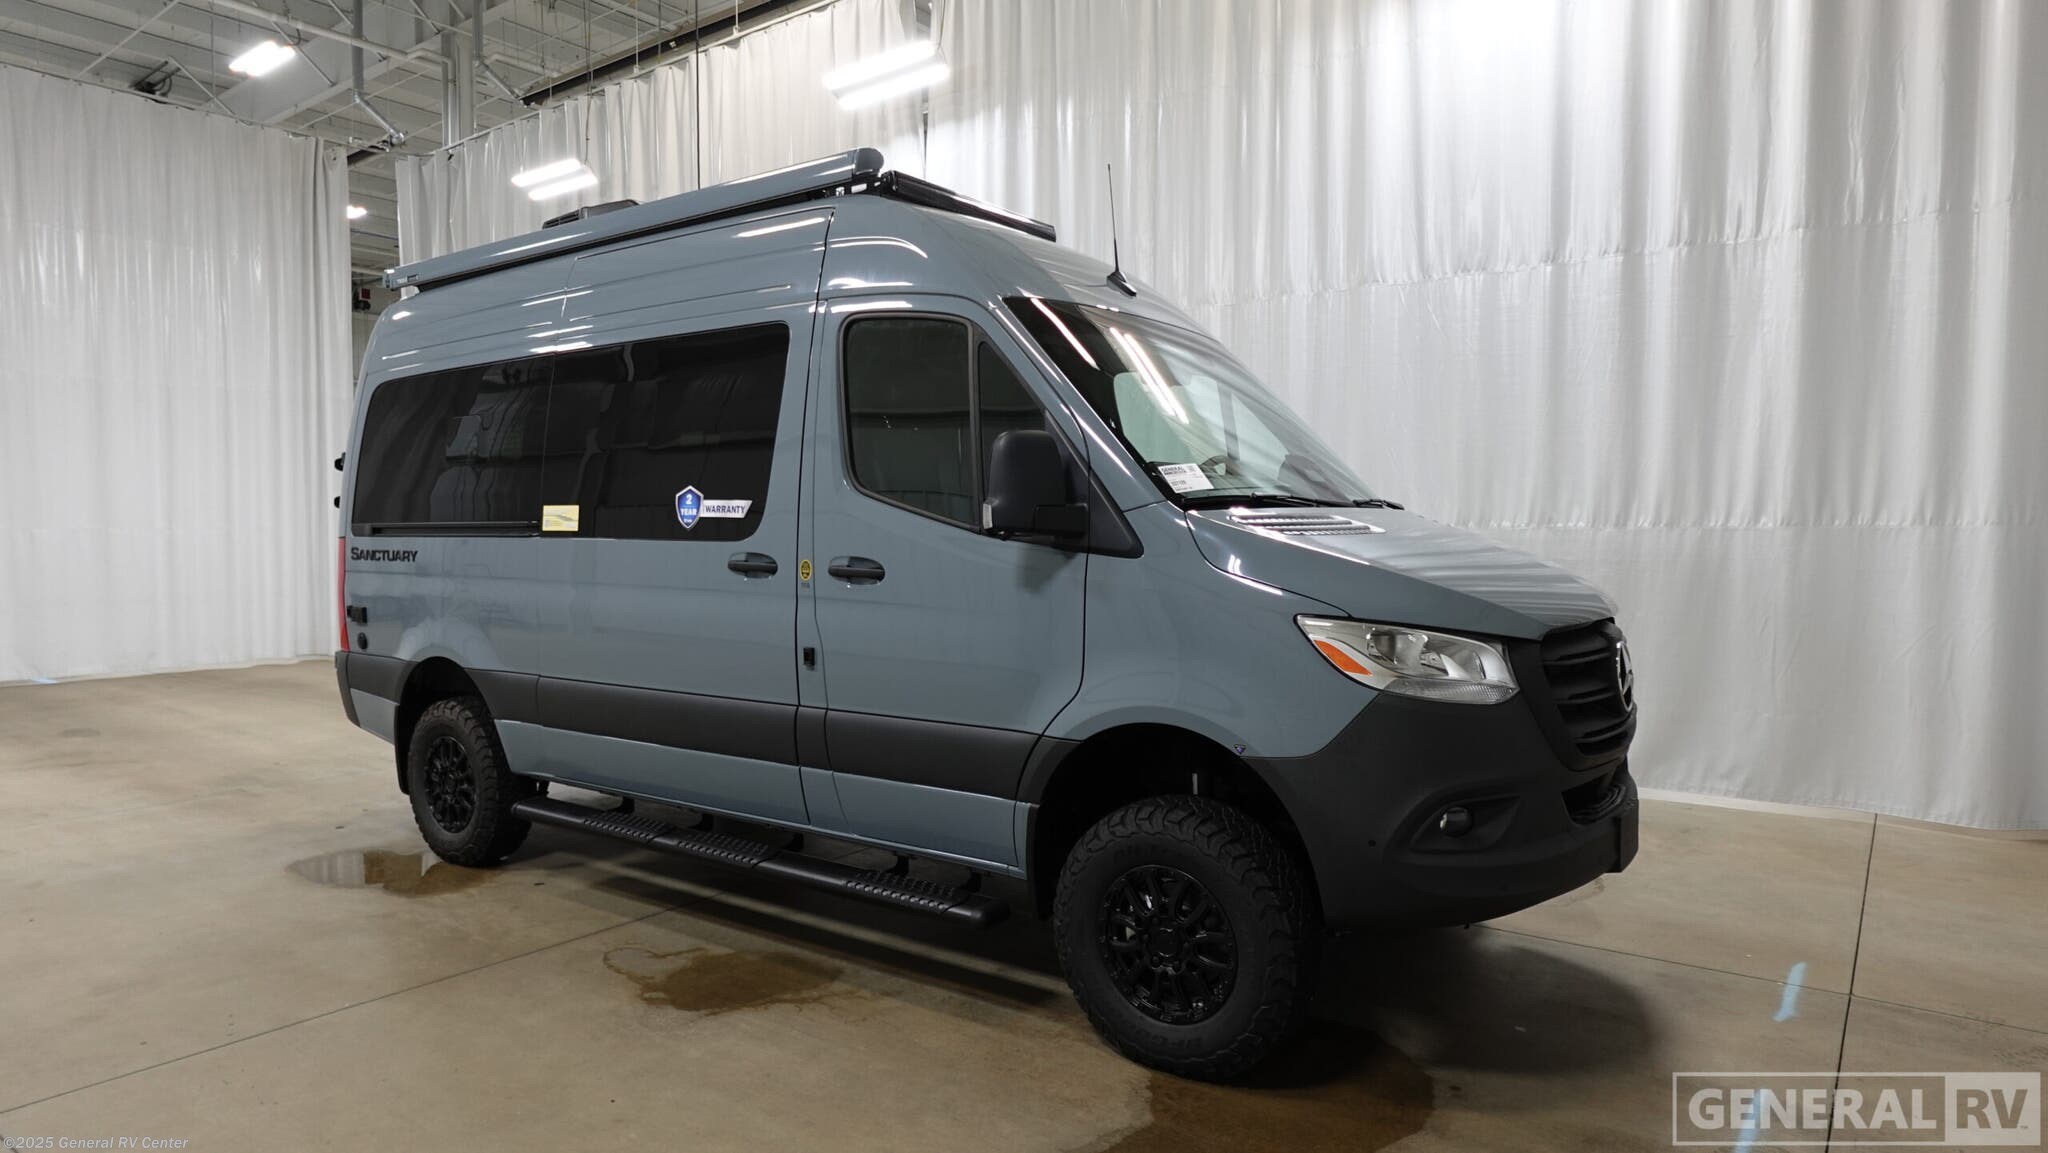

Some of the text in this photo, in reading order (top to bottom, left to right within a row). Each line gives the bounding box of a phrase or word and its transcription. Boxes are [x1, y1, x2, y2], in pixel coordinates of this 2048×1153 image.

[685, 494, 693, 504] 2
[680, 508, 697, 516] YEAR
[705, 505, 746, 514] WARRANTY
[351, 547, 418, 562] SANCTUARY
